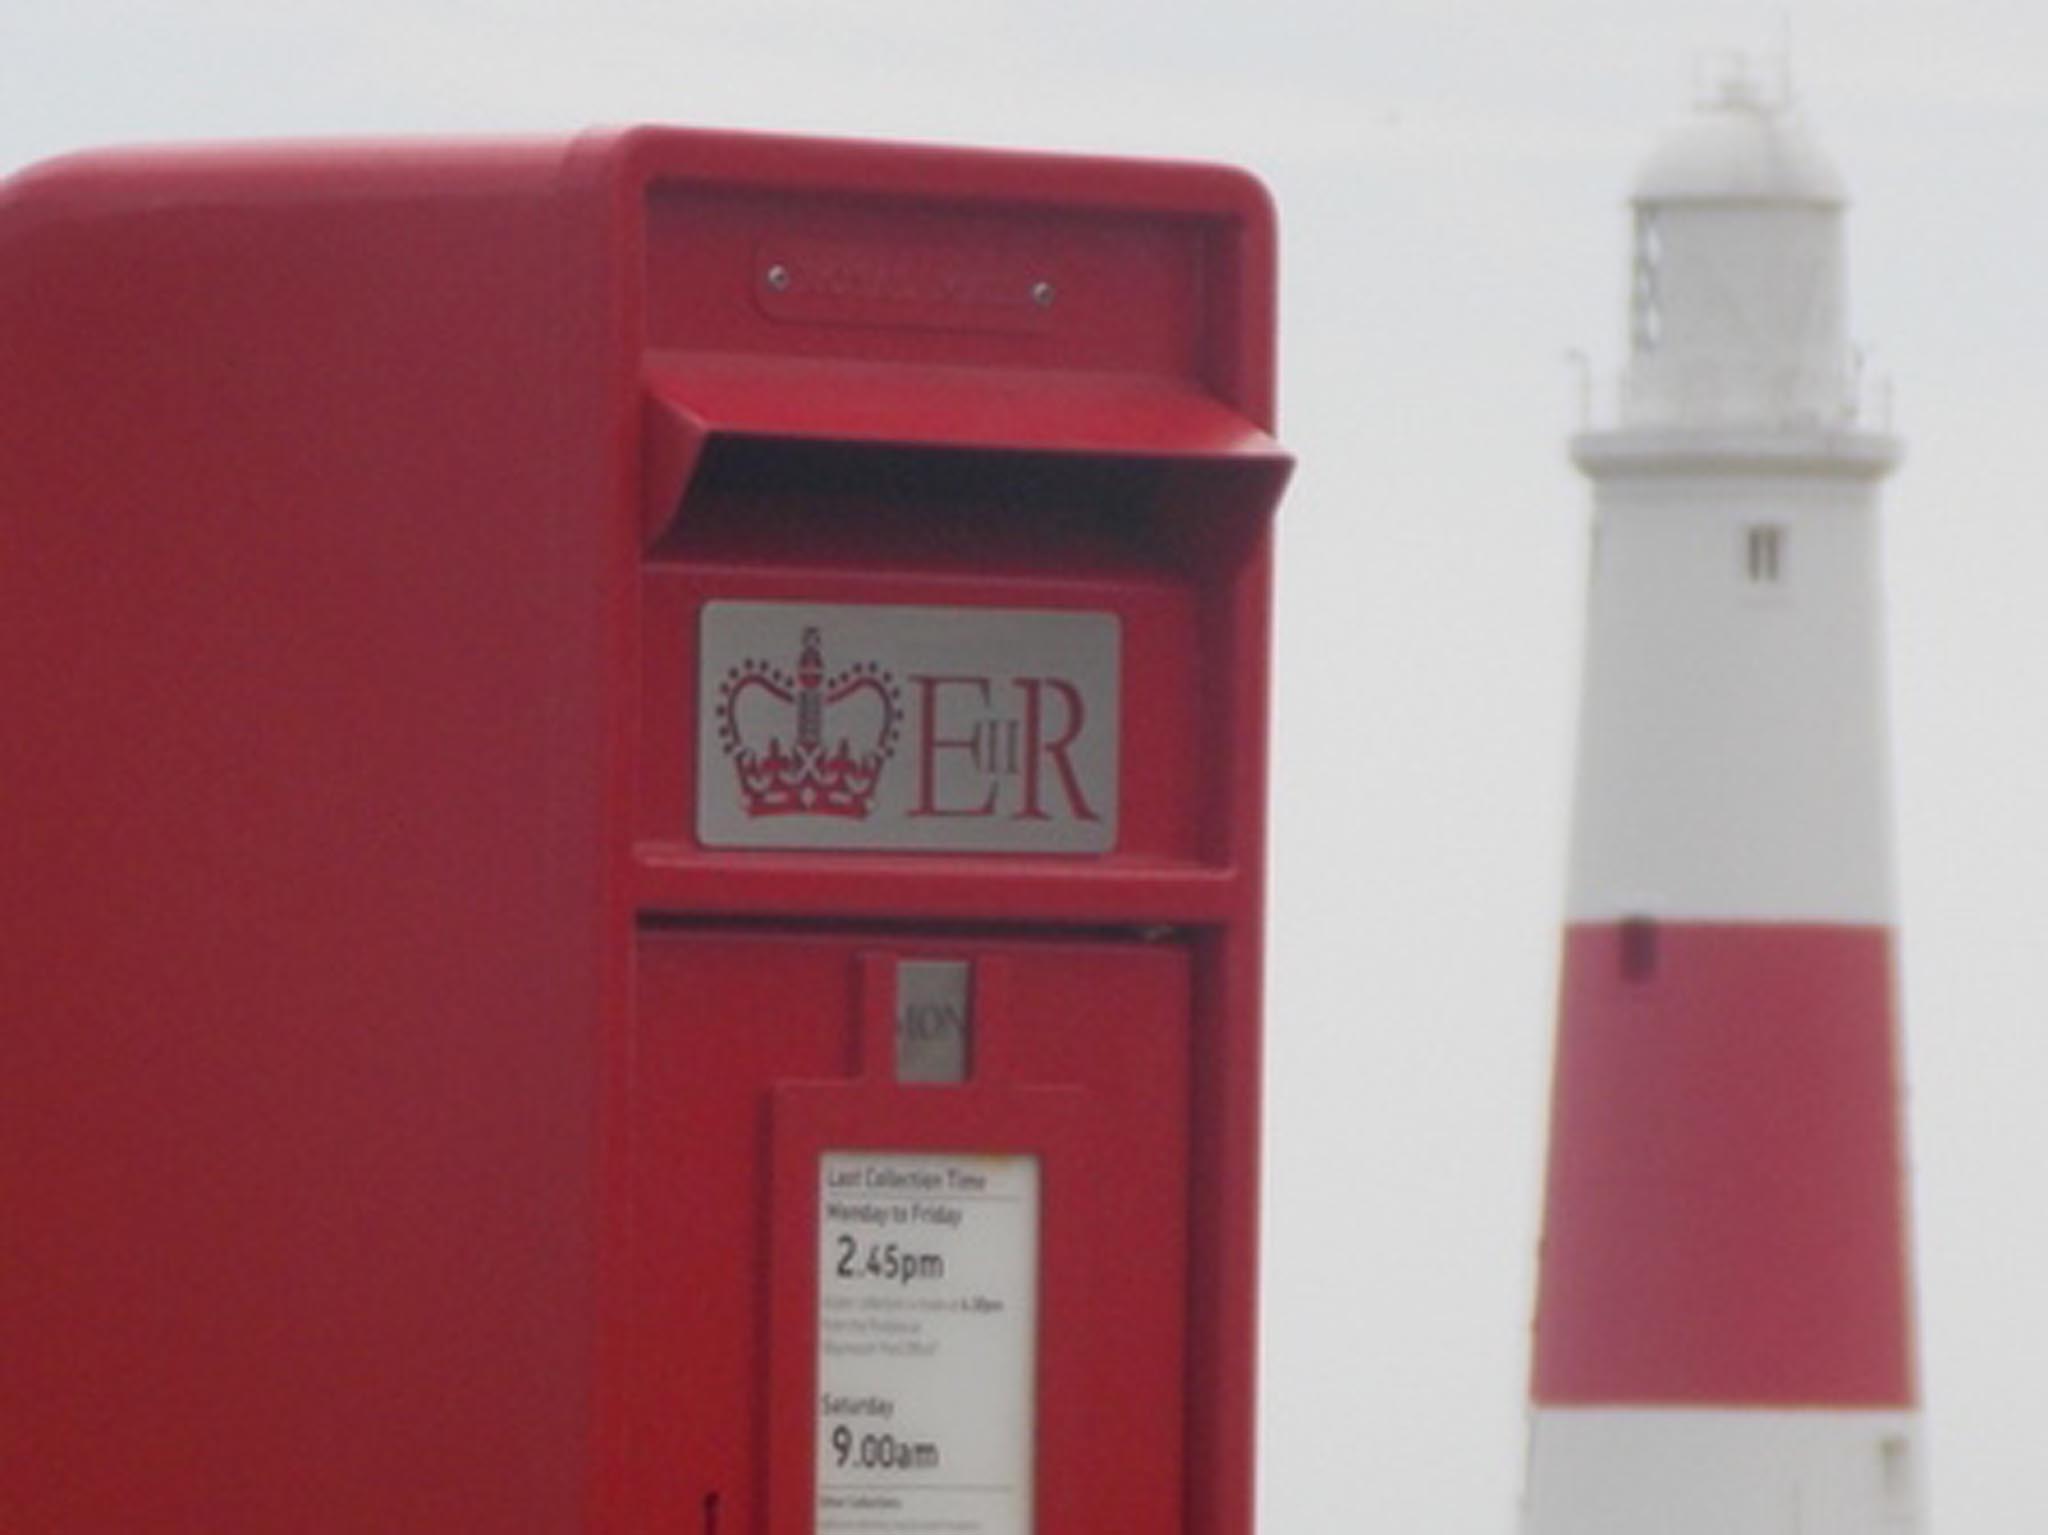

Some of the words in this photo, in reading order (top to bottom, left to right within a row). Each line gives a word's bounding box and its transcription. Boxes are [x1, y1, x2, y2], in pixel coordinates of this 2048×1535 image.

[828, 1168, 860, 1189] Last
[866, 1168, 942, 1190] Collection
[947, 1169, 987, 1190] Time
[827, 1204, 888, 1226] Monday
[893, 1205, 908, 1223] to
[912, 1205, 963, 1228] Friday
[836, 1234, 945, 1286] 2.45pm
[822, 1394, 895, 1420] Saturday
[832, 1424, 940, 1469] 9.00am
